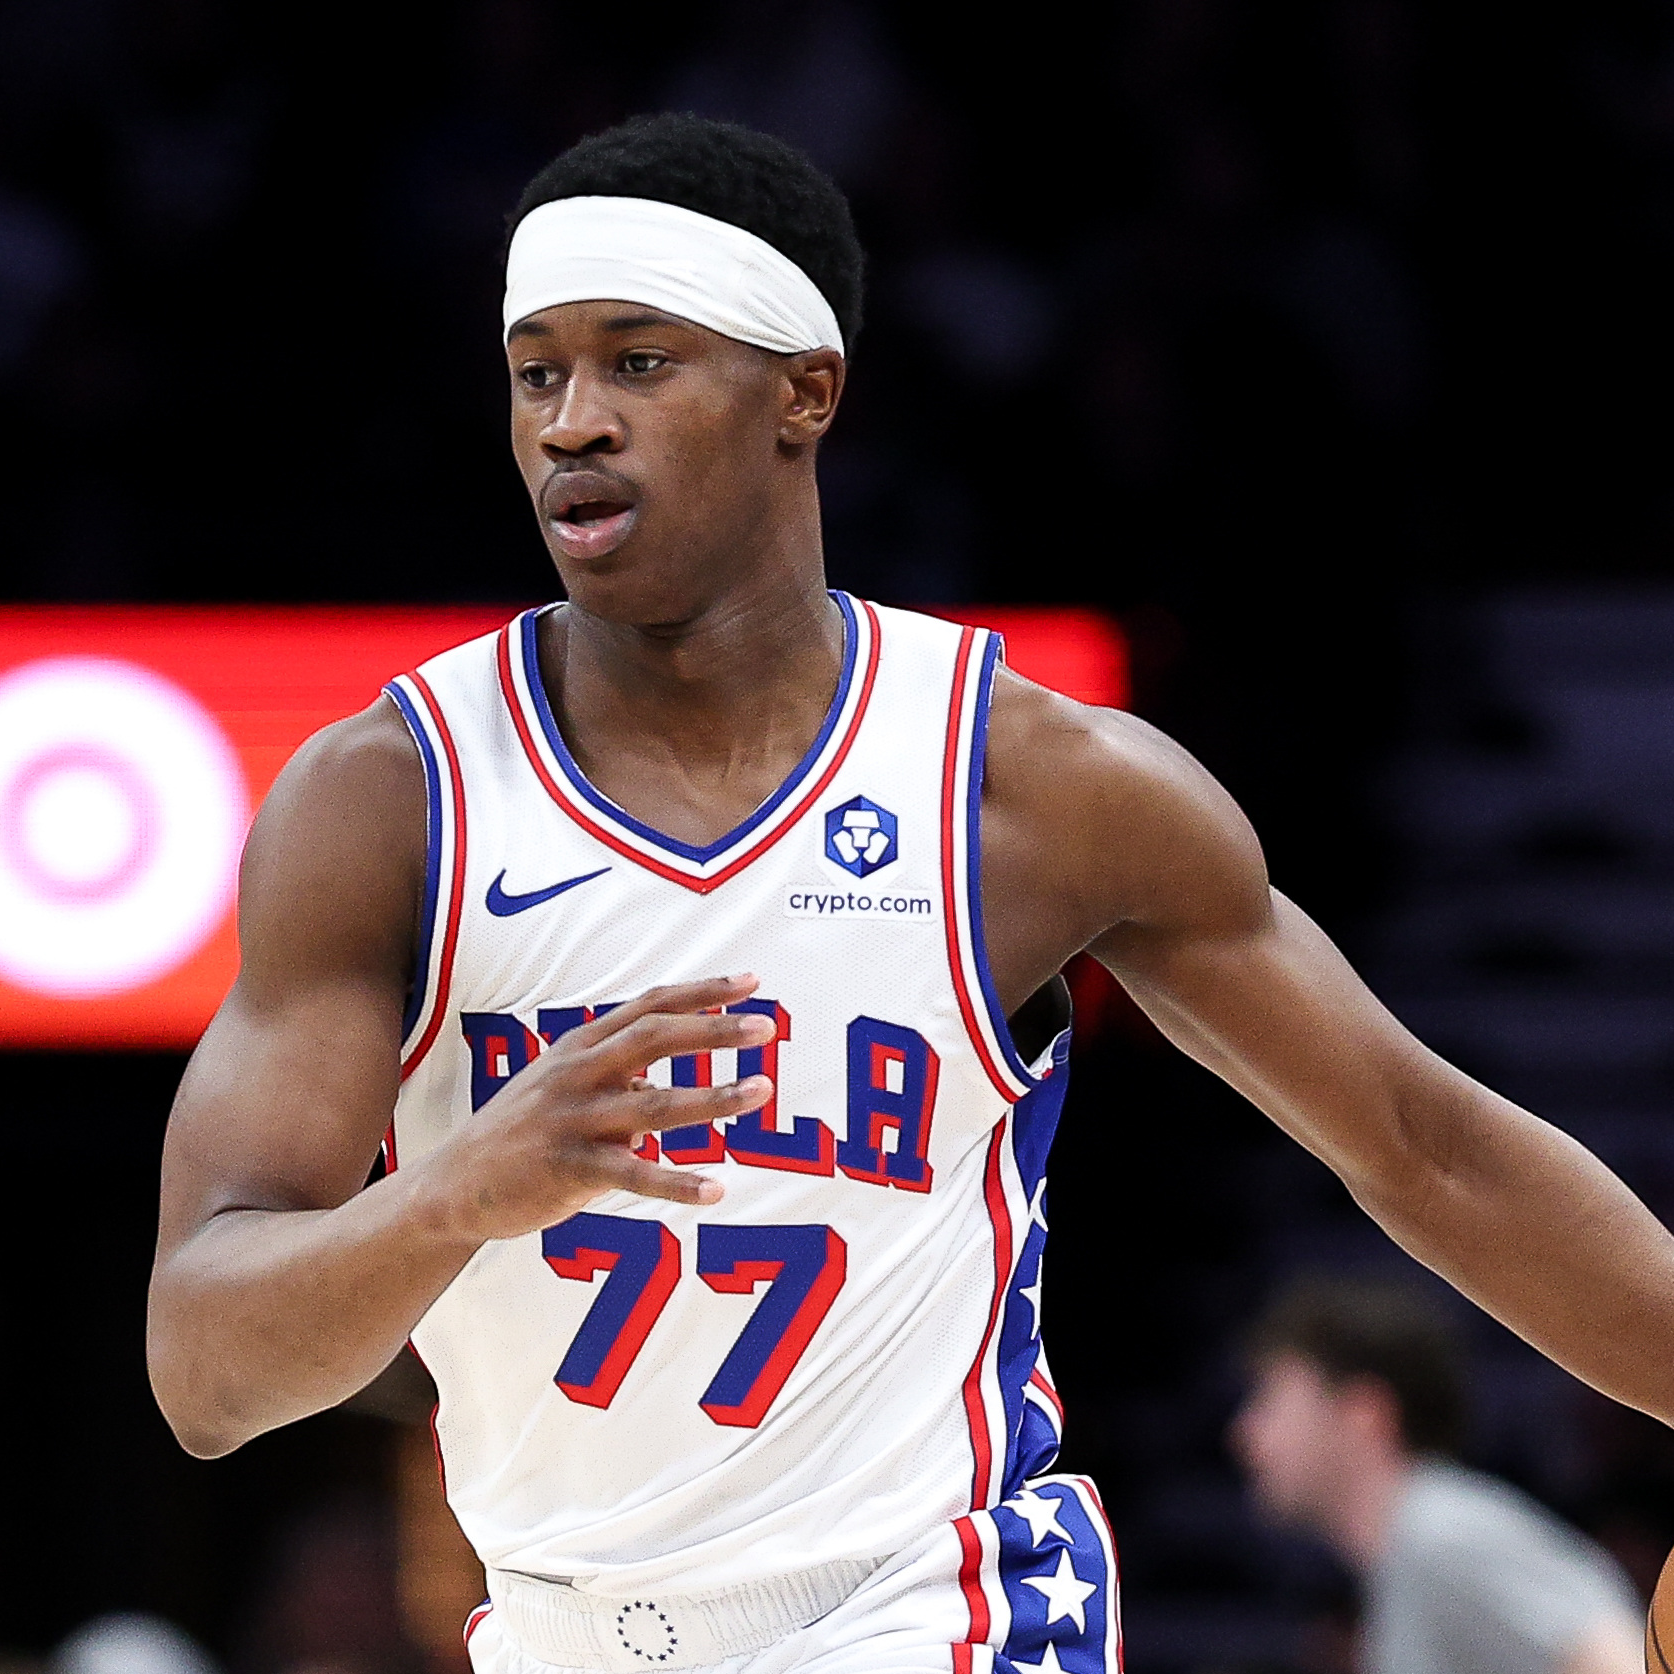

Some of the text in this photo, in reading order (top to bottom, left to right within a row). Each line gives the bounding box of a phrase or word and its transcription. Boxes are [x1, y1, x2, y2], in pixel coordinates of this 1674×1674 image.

[789, 892, 931, 914] crypto.com
[460, 998, 941, 1194] PILA
[541, 1211, 847, 1429] 77
